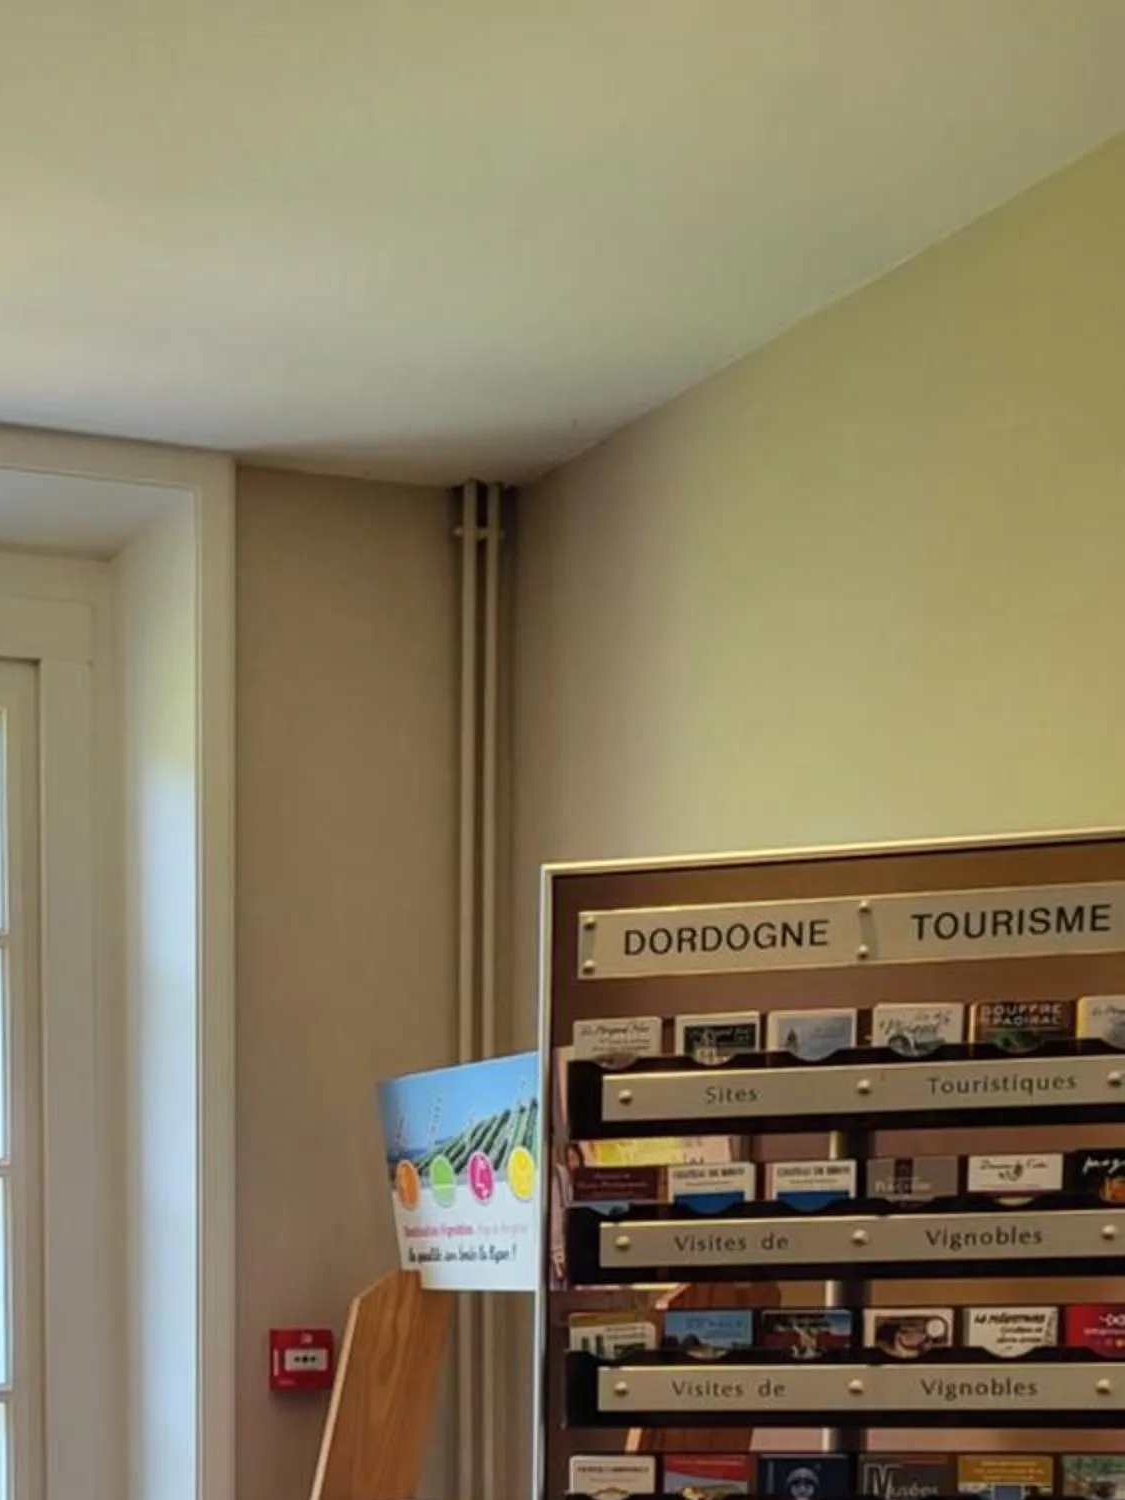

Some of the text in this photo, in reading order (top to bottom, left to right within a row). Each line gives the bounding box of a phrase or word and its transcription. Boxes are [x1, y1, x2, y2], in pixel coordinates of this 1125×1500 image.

[623, 903, 1113, 956] DORDOGNE TOURISME
[705, 1072, 1077, 1104] Sites Touristiques
[674, 1225, 1043, 1252] Visites de Vignobles
[671, 1377, 1039, 1400] Visites de Vignobles
